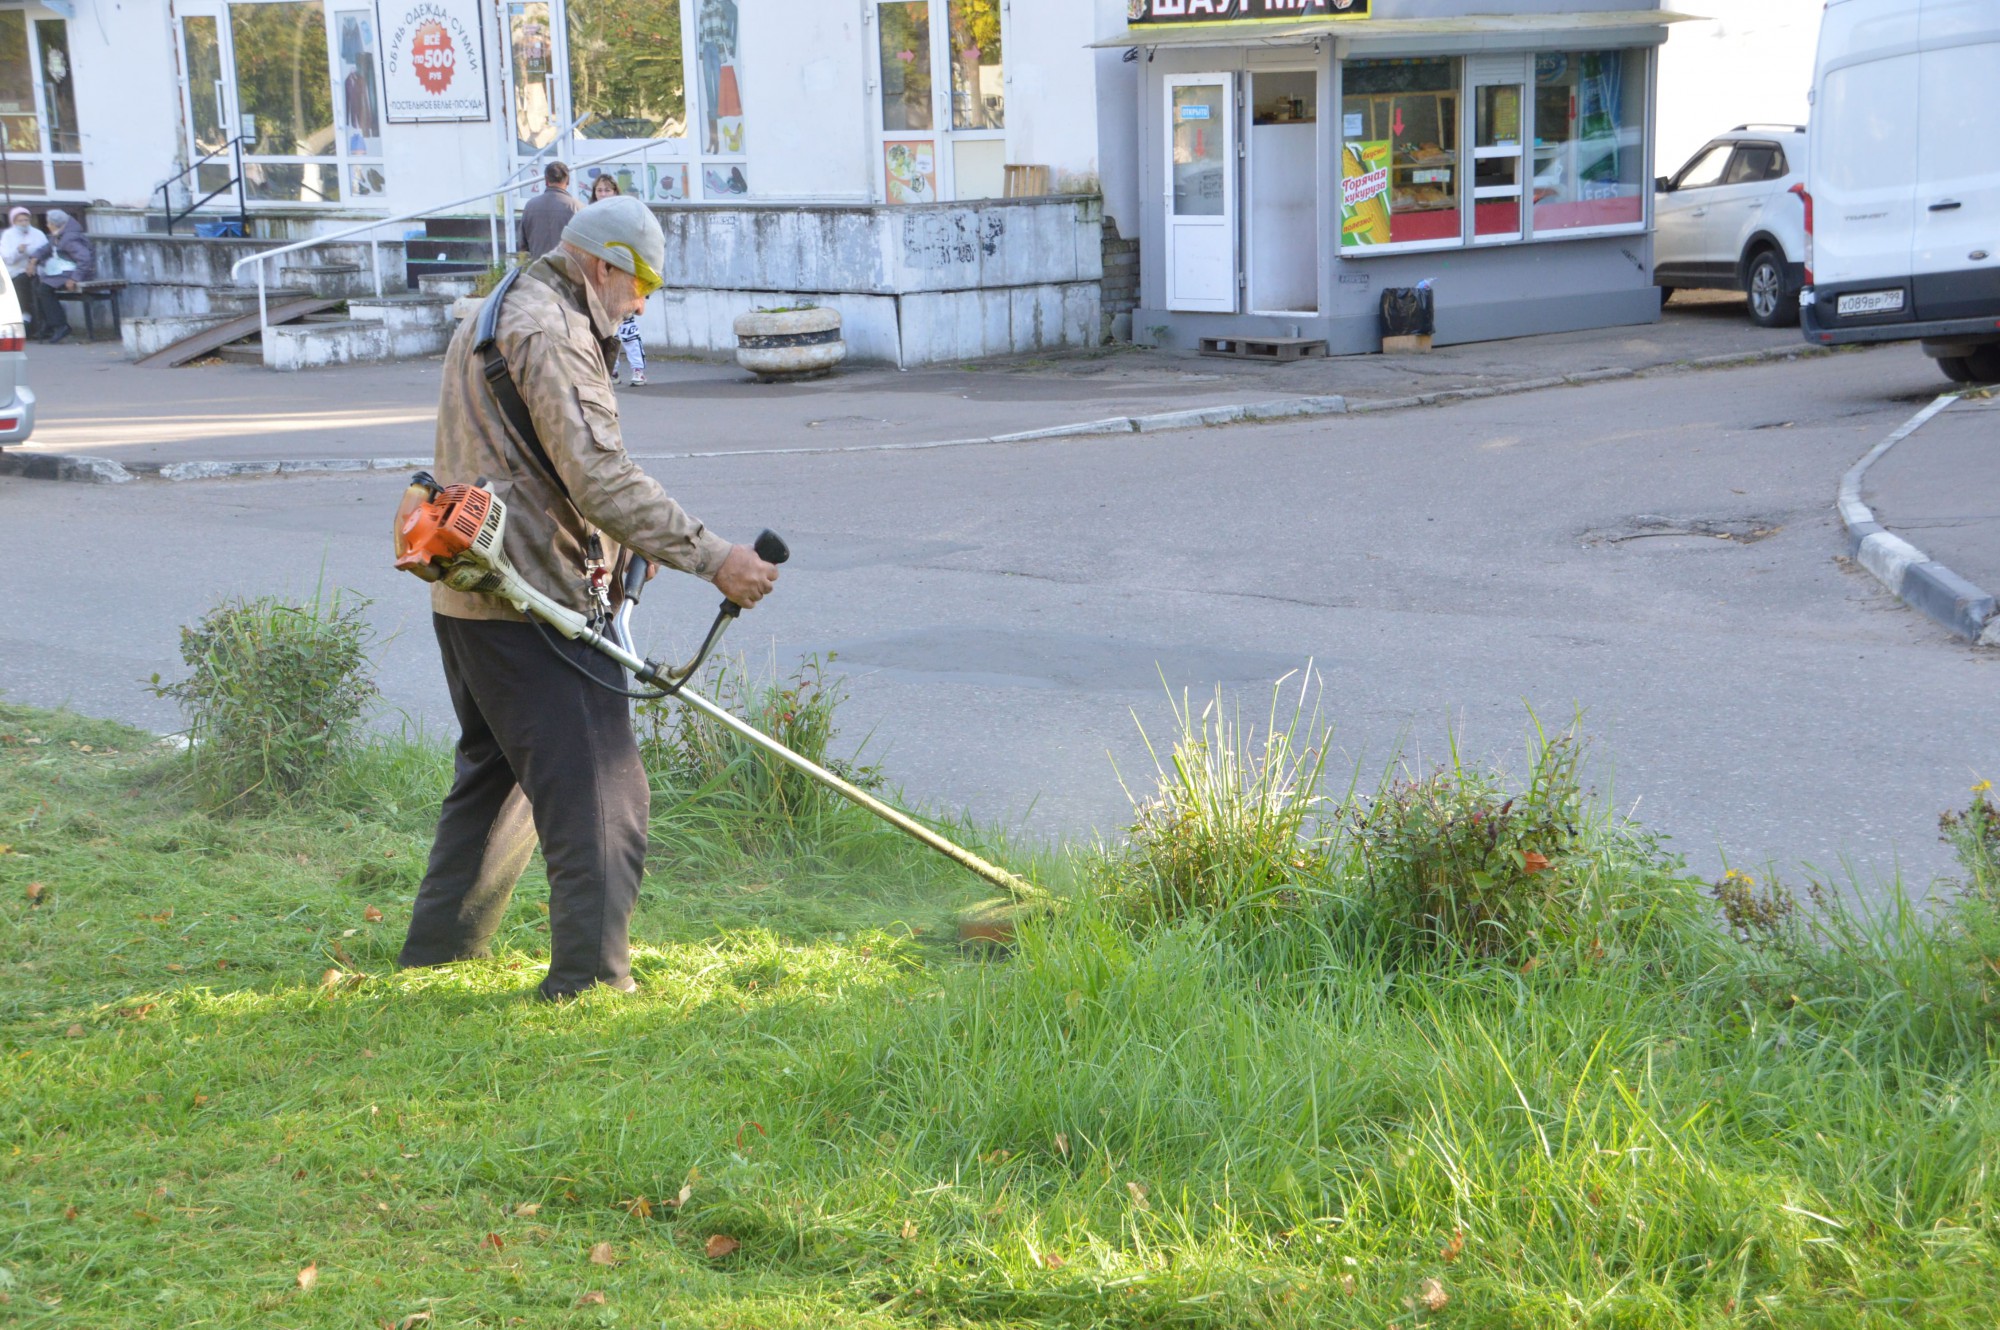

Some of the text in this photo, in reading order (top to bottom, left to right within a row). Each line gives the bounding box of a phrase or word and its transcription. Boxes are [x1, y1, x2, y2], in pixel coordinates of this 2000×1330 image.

[389, 27, 405, 73] ОБУВЬ
[406, 2, 447, 24] ОДЕЖДА
[451, 17, 478, 71] СУМКИ
[424, 48, 453, 68] 500
[1342, 169, 1386, 192] Горячая
[1344, 181, 1386, 204] кукуруза
